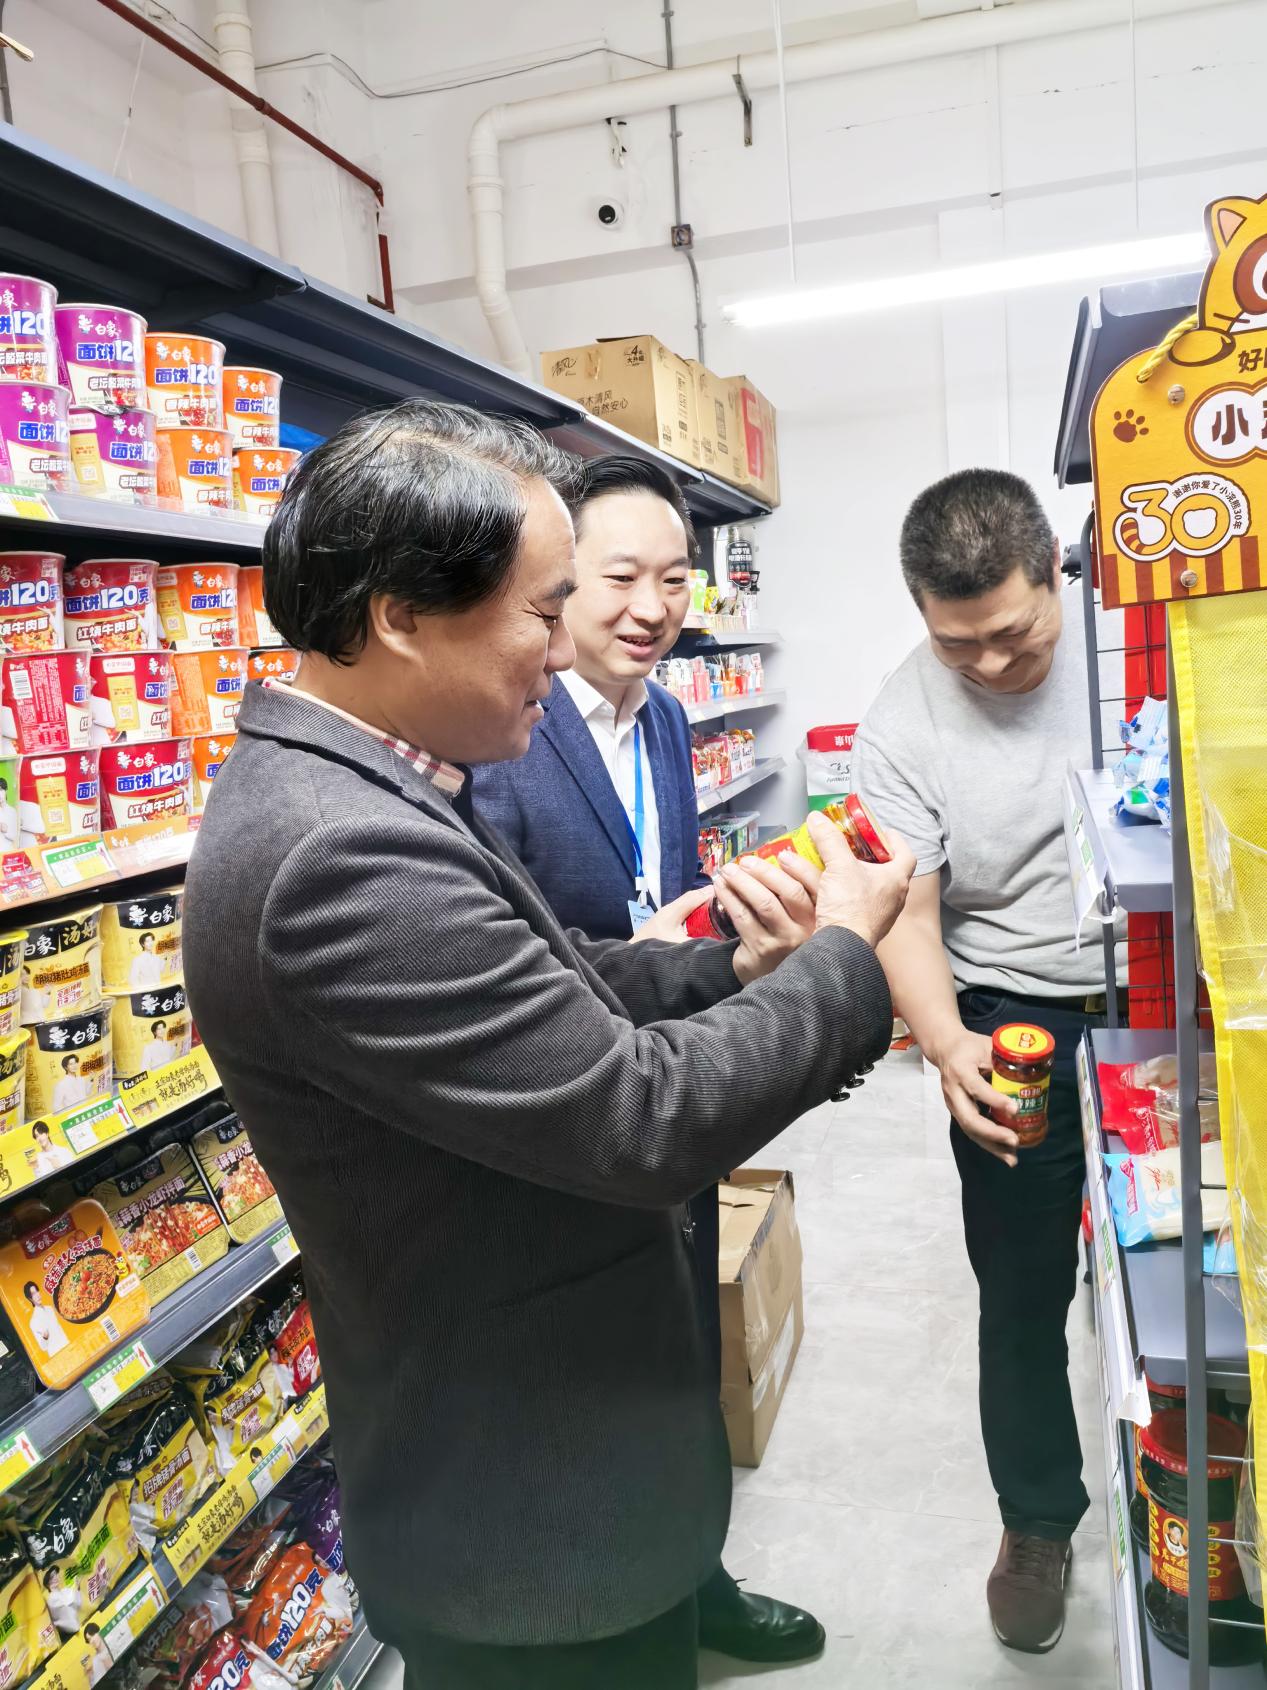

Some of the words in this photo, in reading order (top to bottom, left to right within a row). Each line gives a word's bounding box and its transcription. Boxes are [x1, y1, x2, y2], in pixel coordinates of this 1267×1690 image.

[95, 319, 120, 338] 白象
[171, 346, 195, 363] 白象
[1238, 347, 1267, 375] 好
[1211, 400, 1267, 446] 小
[1172, 479, 1243, 531] 谢谢你爱了小浣熊30年
[65, 585, 151, 615] 面饼120克
[77, 617, 138, 642] 红烧牛肉面
[134, 752, 159, 769] 白象
[128, 793, 185, 819] 红烧牛肉面
[149, 904, 177, 924] 白象
[161, 989, 186, 1013] 白象
[72, 1021, 101, 1045] 白象
[38, 1232, 55, 1250] 白象
[51, 1515, 77, 1556] 白象
